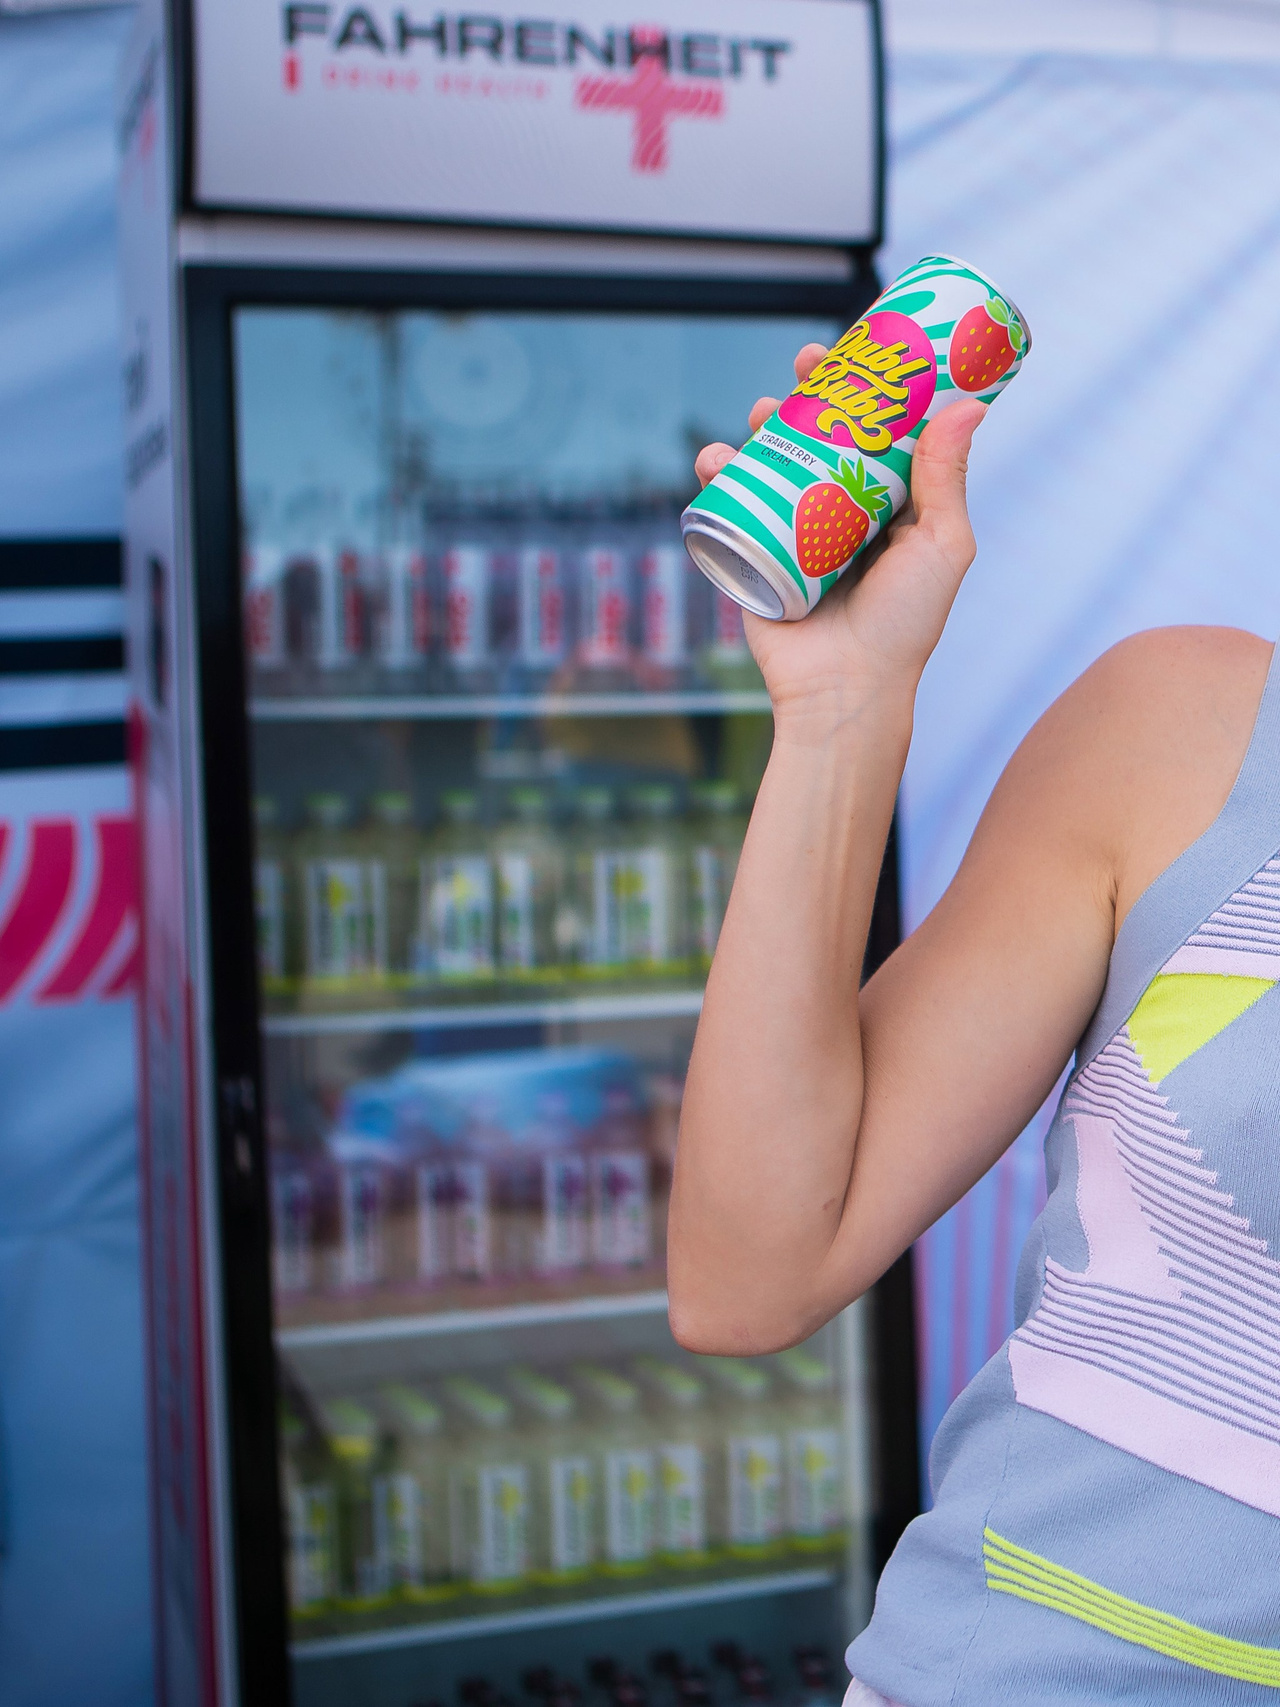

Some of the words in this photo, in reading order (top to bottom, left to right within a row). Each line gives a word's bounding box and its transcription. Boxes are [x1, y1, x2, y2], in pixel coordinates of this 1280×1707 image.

[283, 3, 794, 82] FAHRENHEIT
[790, 357, 909, 457] Bubl
[758, 434, 818, 467] STRAWBERRY
[760, 446, 793, 467] CREAM
